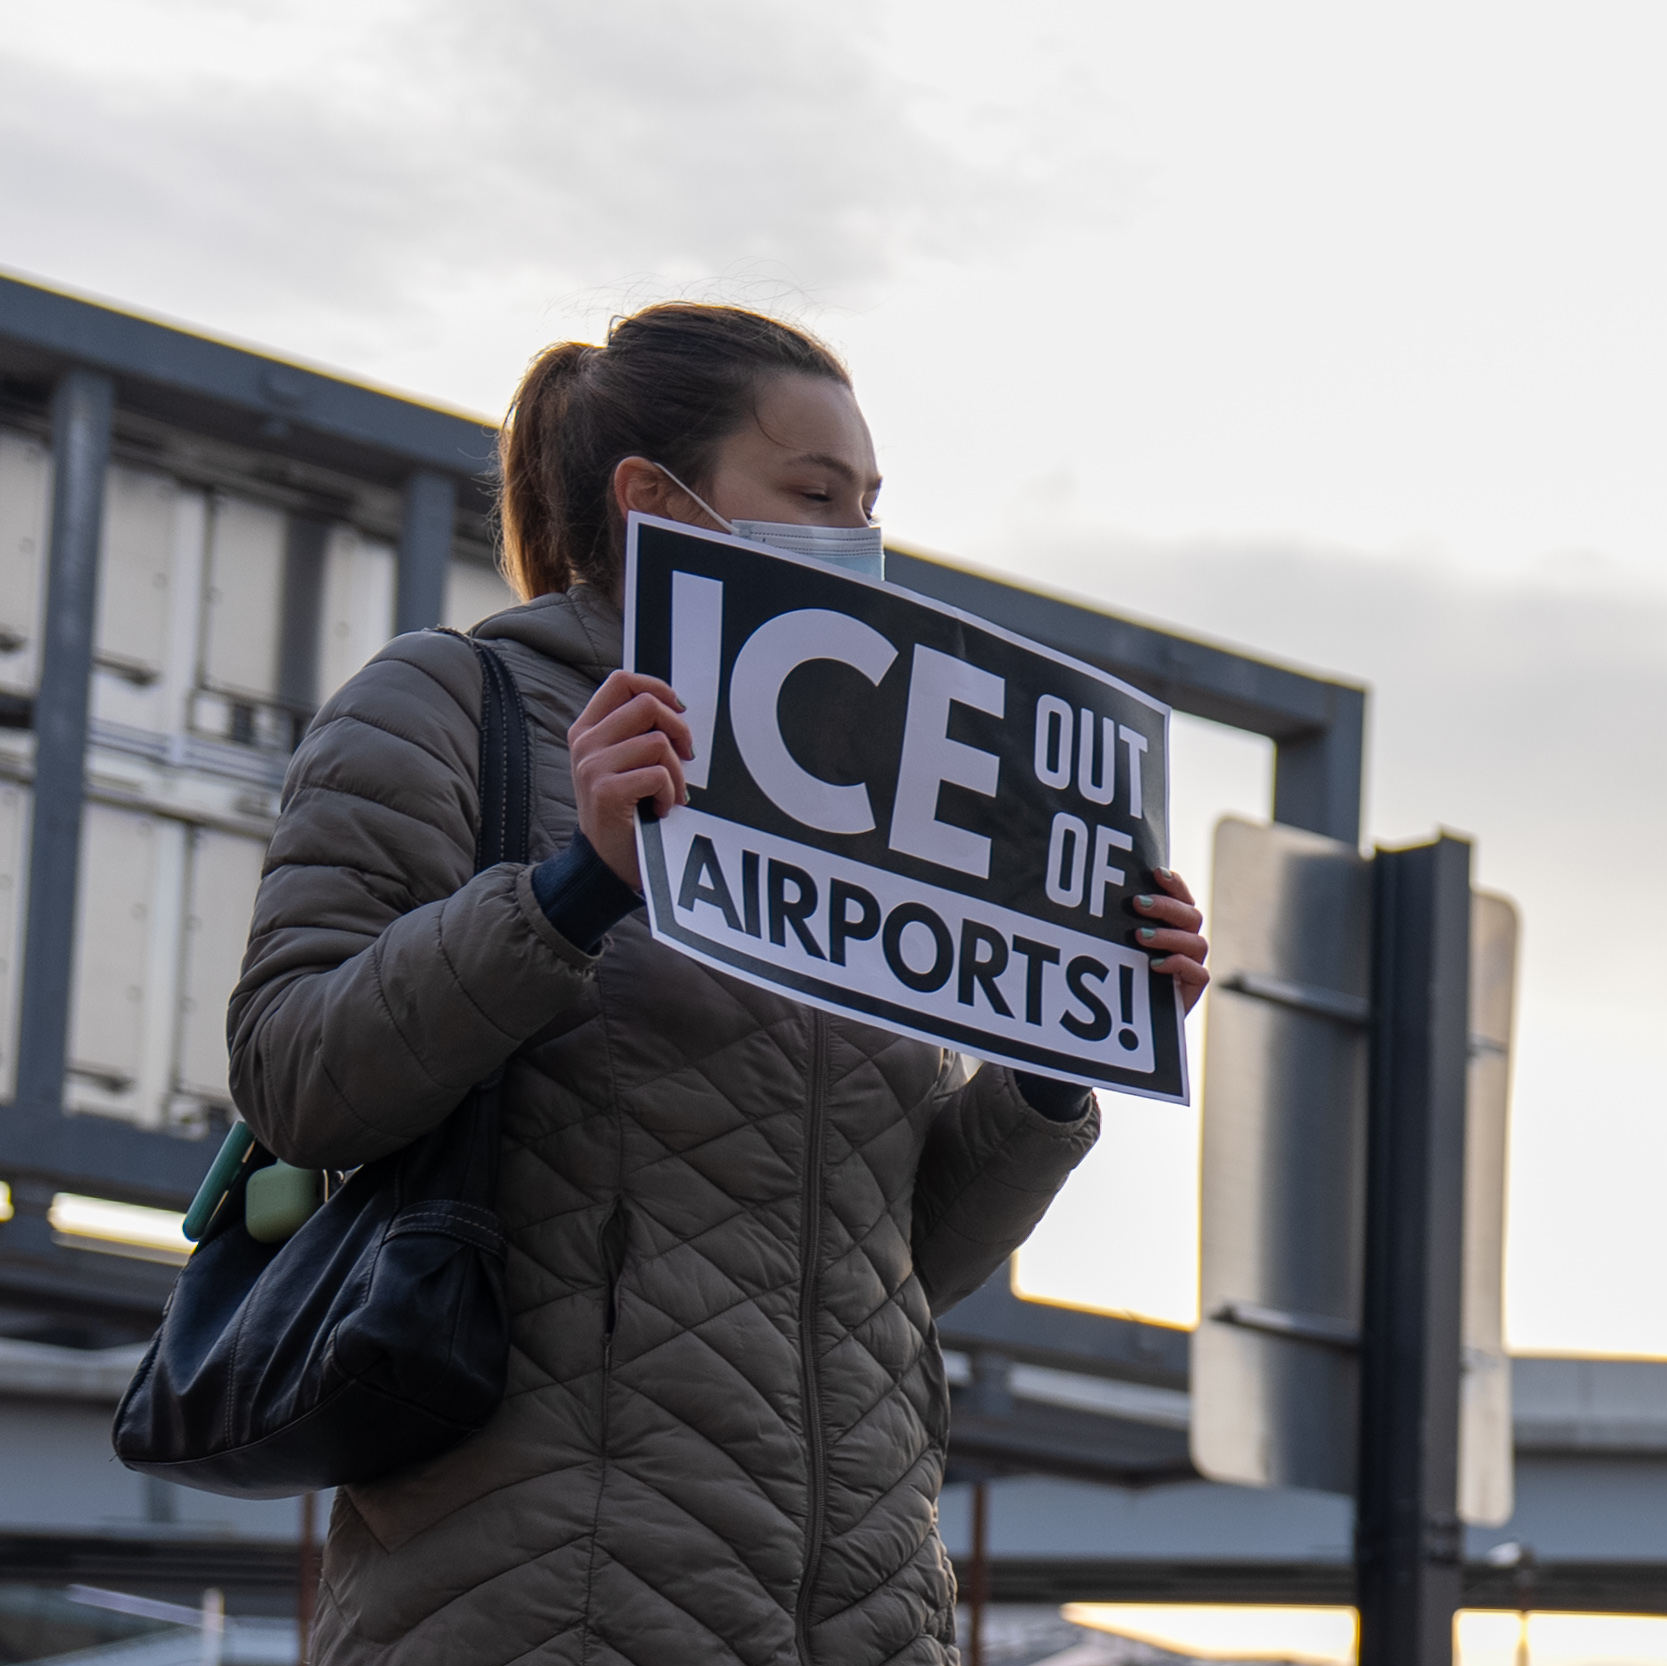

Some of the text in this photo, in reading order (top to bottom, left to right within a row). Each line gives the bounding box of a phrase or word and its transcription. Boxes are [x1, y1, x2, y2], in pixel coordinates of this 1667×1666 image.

[671, 570, 1005, 880] ICE
[1033, 694, 1148, 820] OUT
[677, 834, 1140, 1052] AIRPORTS!
[1045, 811, 1133, 917] OF
